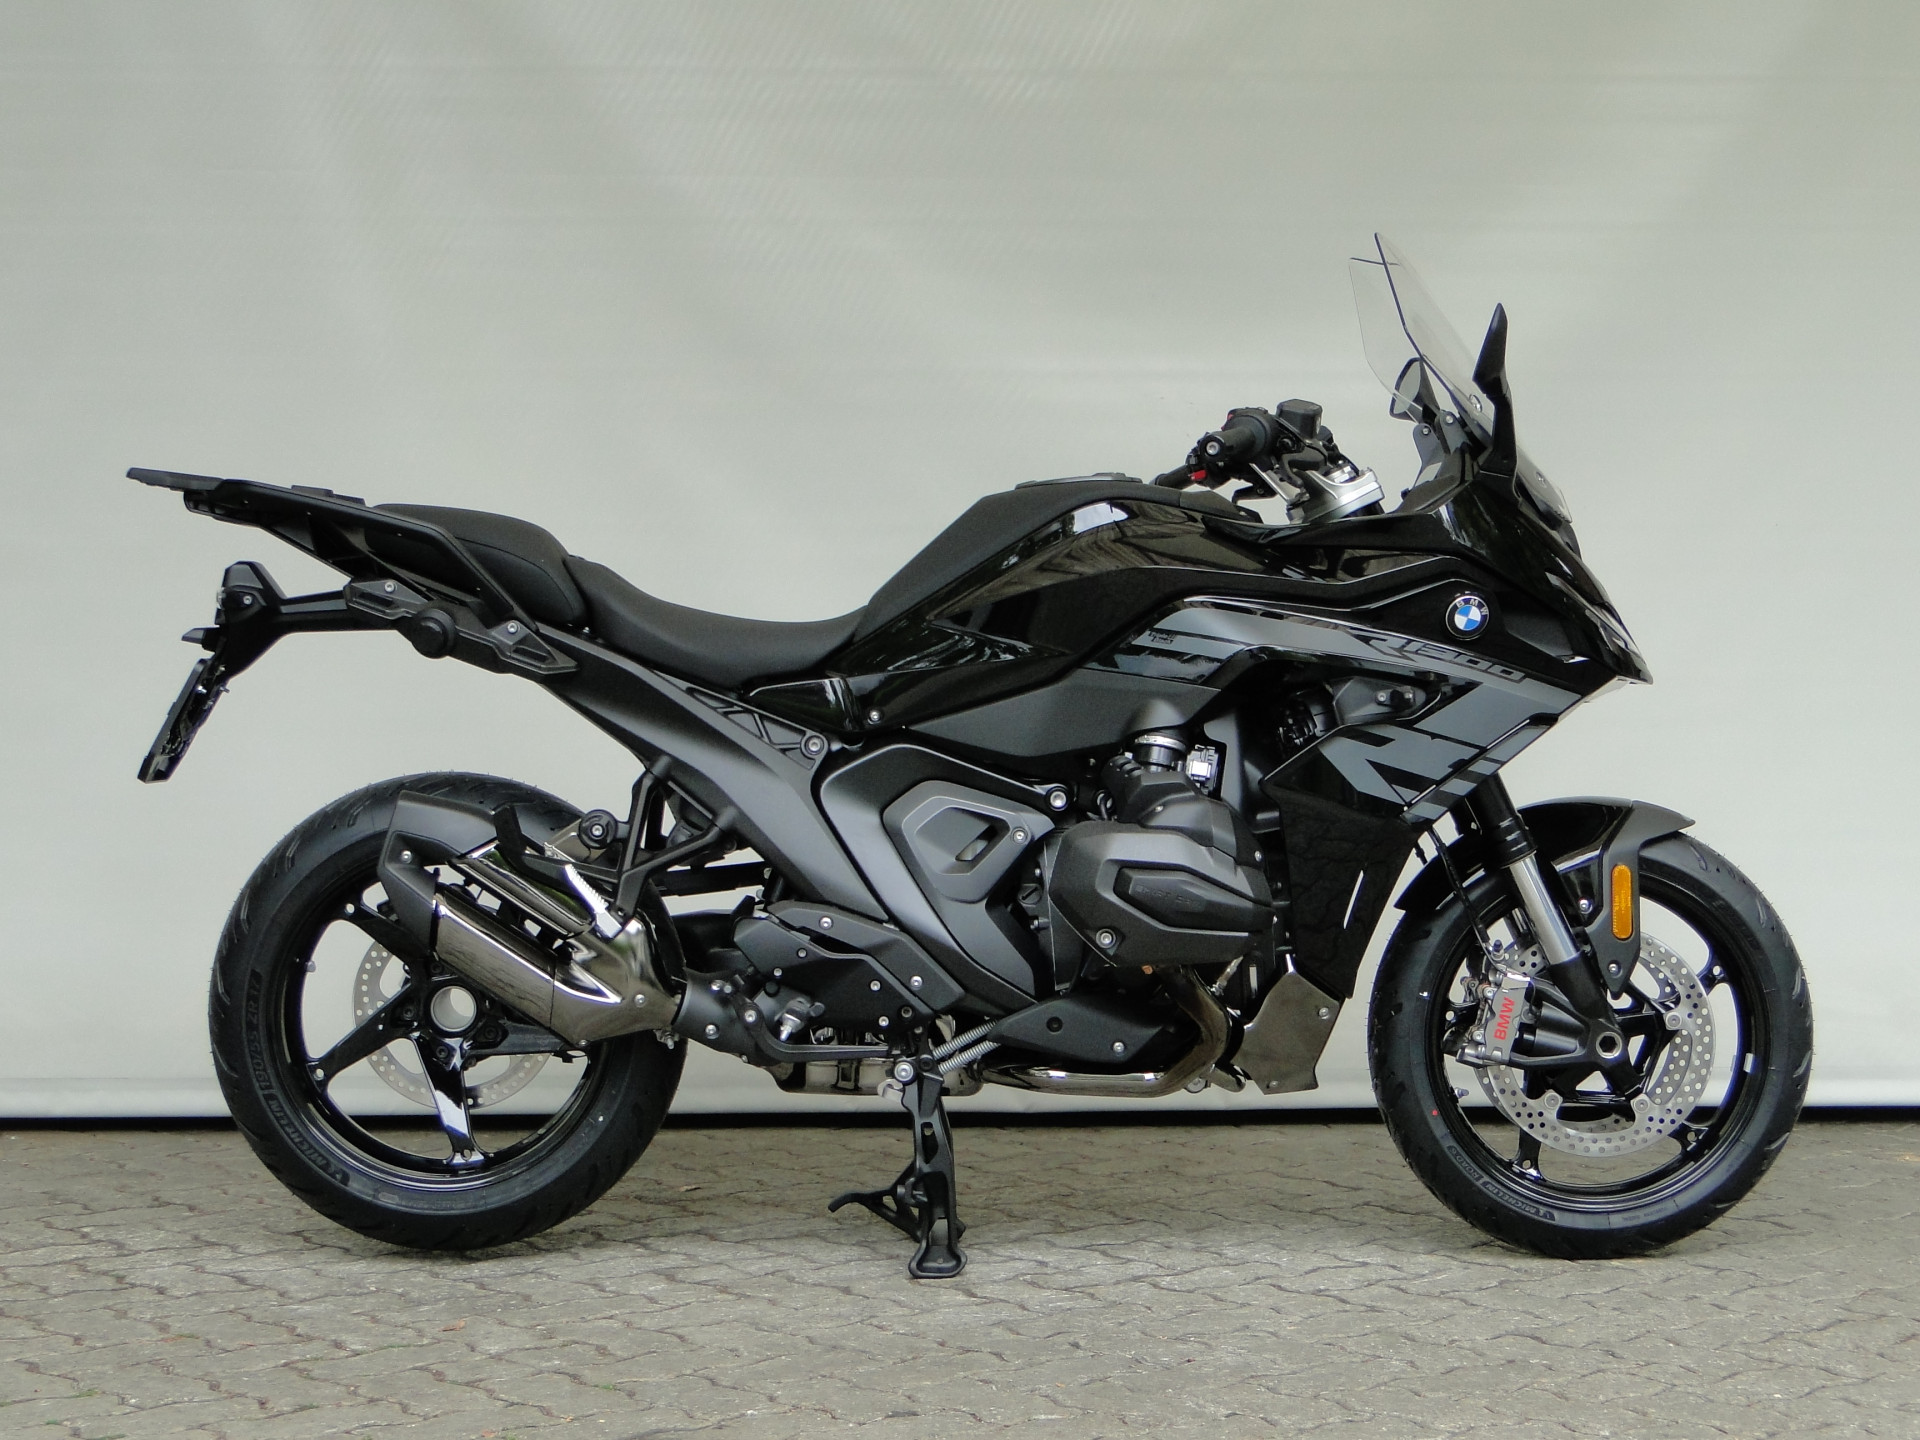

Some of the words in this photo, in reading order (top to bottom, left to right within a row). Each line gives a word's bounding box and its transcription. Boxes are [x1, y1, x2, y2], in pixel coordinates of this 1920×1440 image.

[1456, 598, 1489, 615] BMW
[246, 1000, 258, 1026] ZR
[1494, 996, 1515, 1041] BMW
[247, 1030, 272, 1090] 190/55
[267, 1097, 328, 1169] MICHELIN
[1453, 1153, 1481, 1180] ROAD
[1483, 1181, 1537, 1213] MICHELIN
